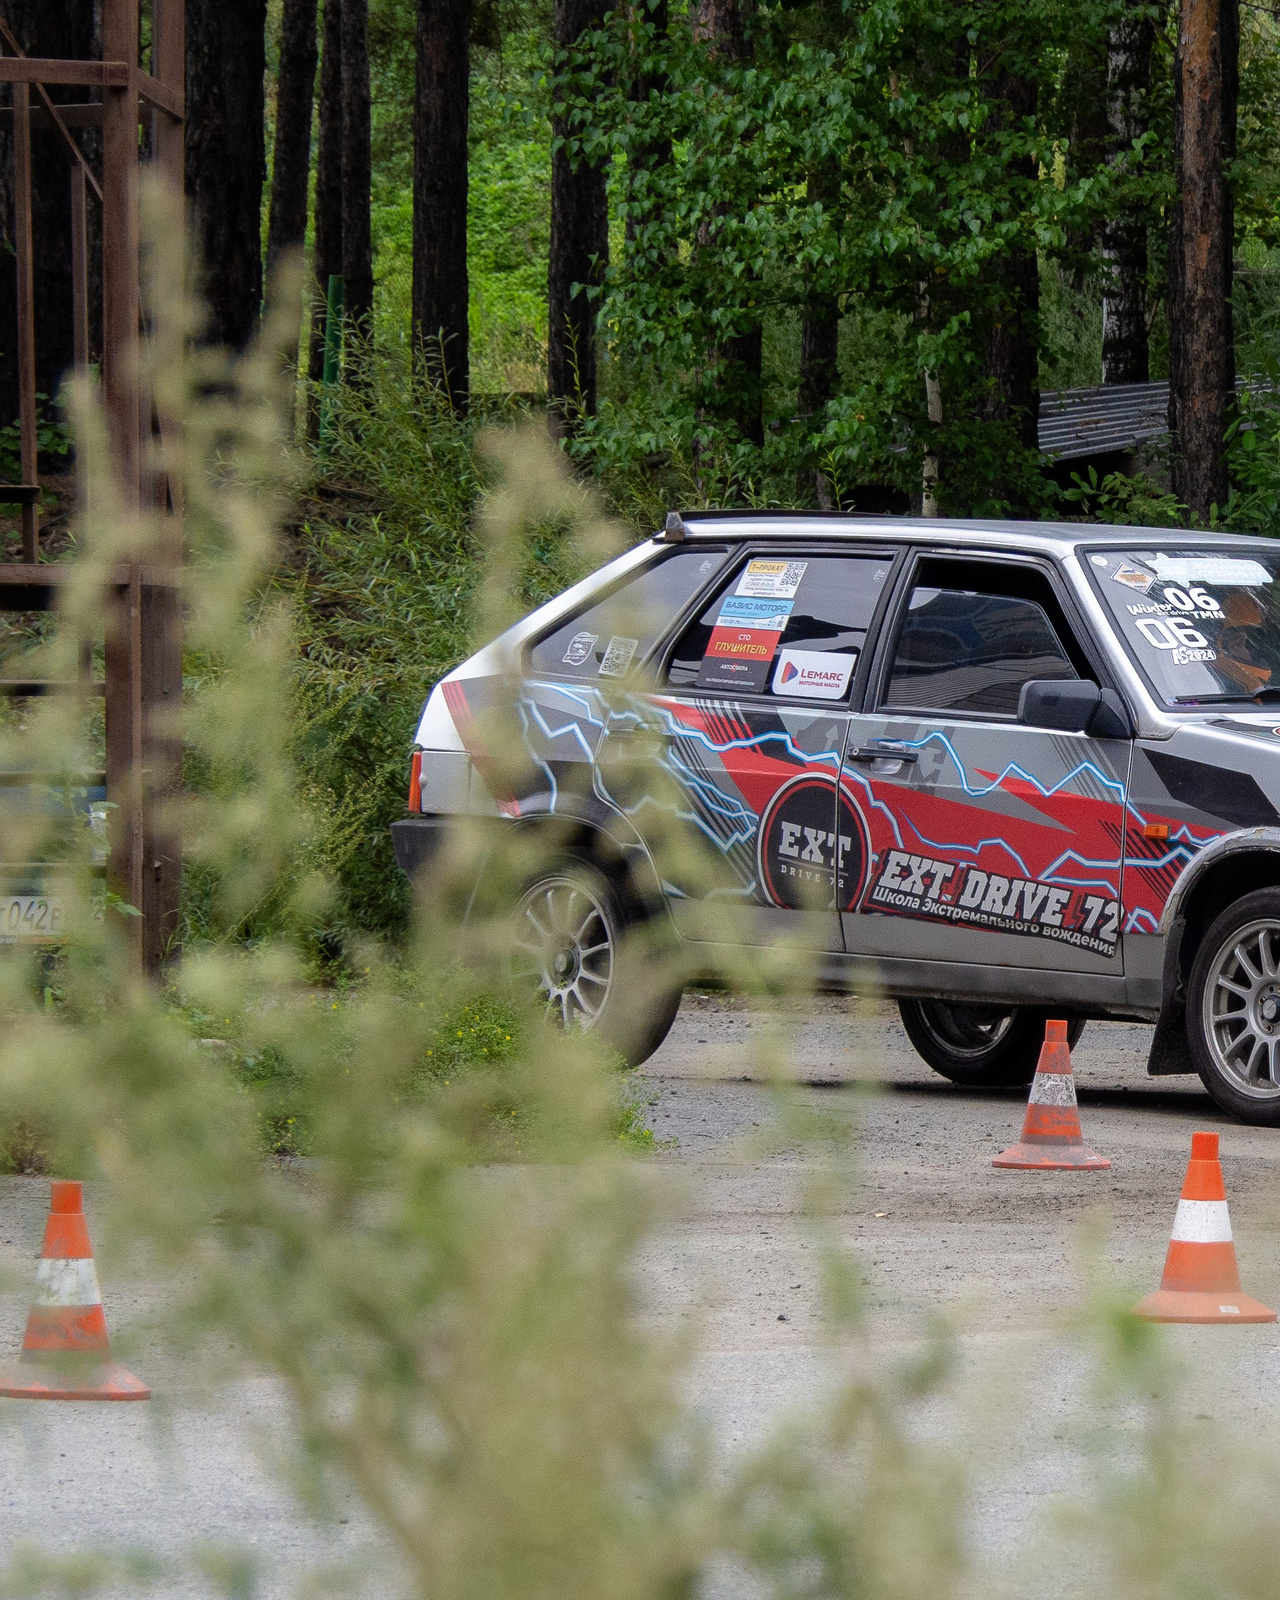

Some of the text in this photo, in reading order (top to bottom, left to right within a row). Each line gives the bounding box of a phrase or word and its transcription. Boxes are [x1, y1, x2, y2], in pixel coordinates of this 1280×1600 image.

[726, 602, 753, 610] БАЗИС
[754, 604, 787, 613] МОТОРС
[1163, 588, 1220, 611] 06
[1126, 602, 1175, 616] Winter
[1190, 610, 1226, 619] TMN
[738, 633, 752, 641] СТО
[1135, 617, 1208, 650] 06
[714, 641, 768, 655] ГЛУШИТЕЛЬ
[800, 668, 844, 682] LEMARC
[779, 821, 851, 868] EXT
[781, 864, 844, 888] DRIVE 72
[878, 850, 1119, 943] EXT DRIVE 72
[872, 886, 1116, 957] Школа Экстремального вождения
